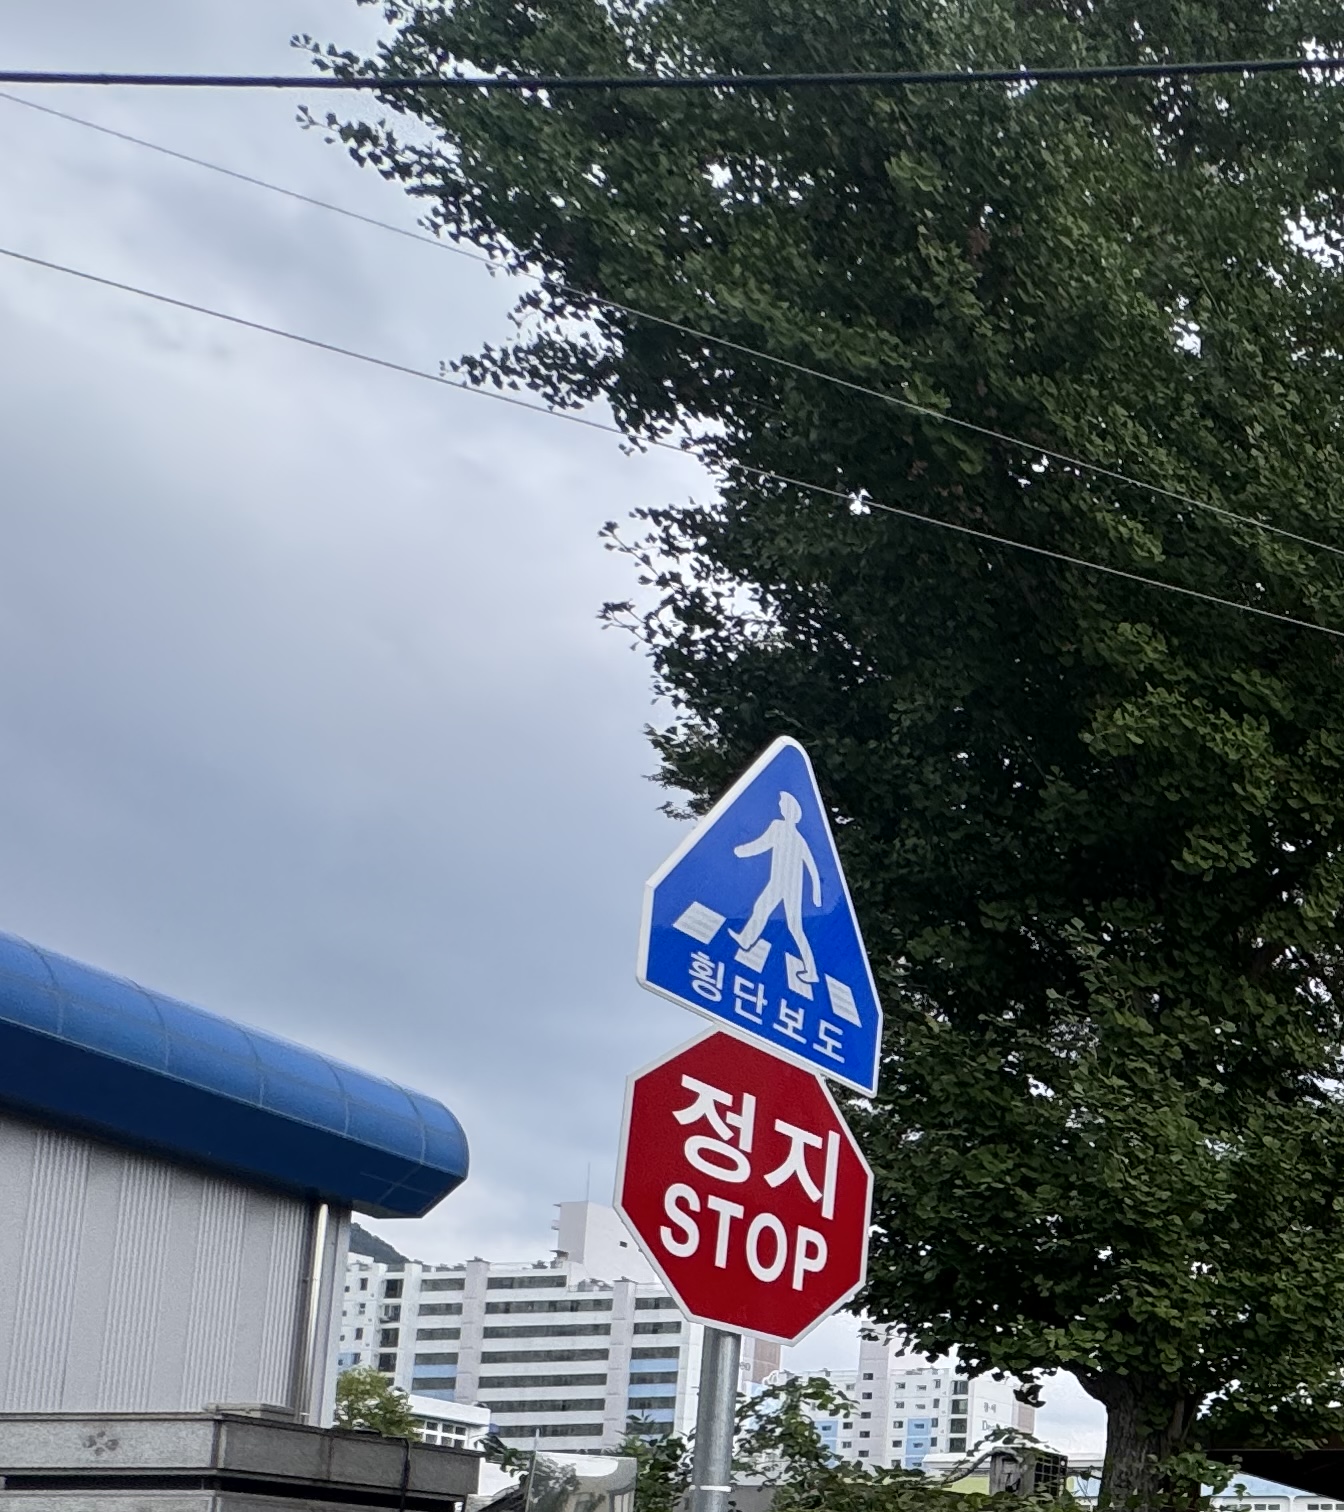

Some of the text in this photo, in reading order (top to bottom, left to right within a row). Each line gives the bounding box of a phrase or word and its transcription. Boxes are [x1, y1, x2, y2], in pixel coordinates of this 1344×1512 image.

[687, 950, 846, 1065] 횡단보도
[672, 1073, 842, 1220] 정지
[659, 1182, 829, 1292] STOP
